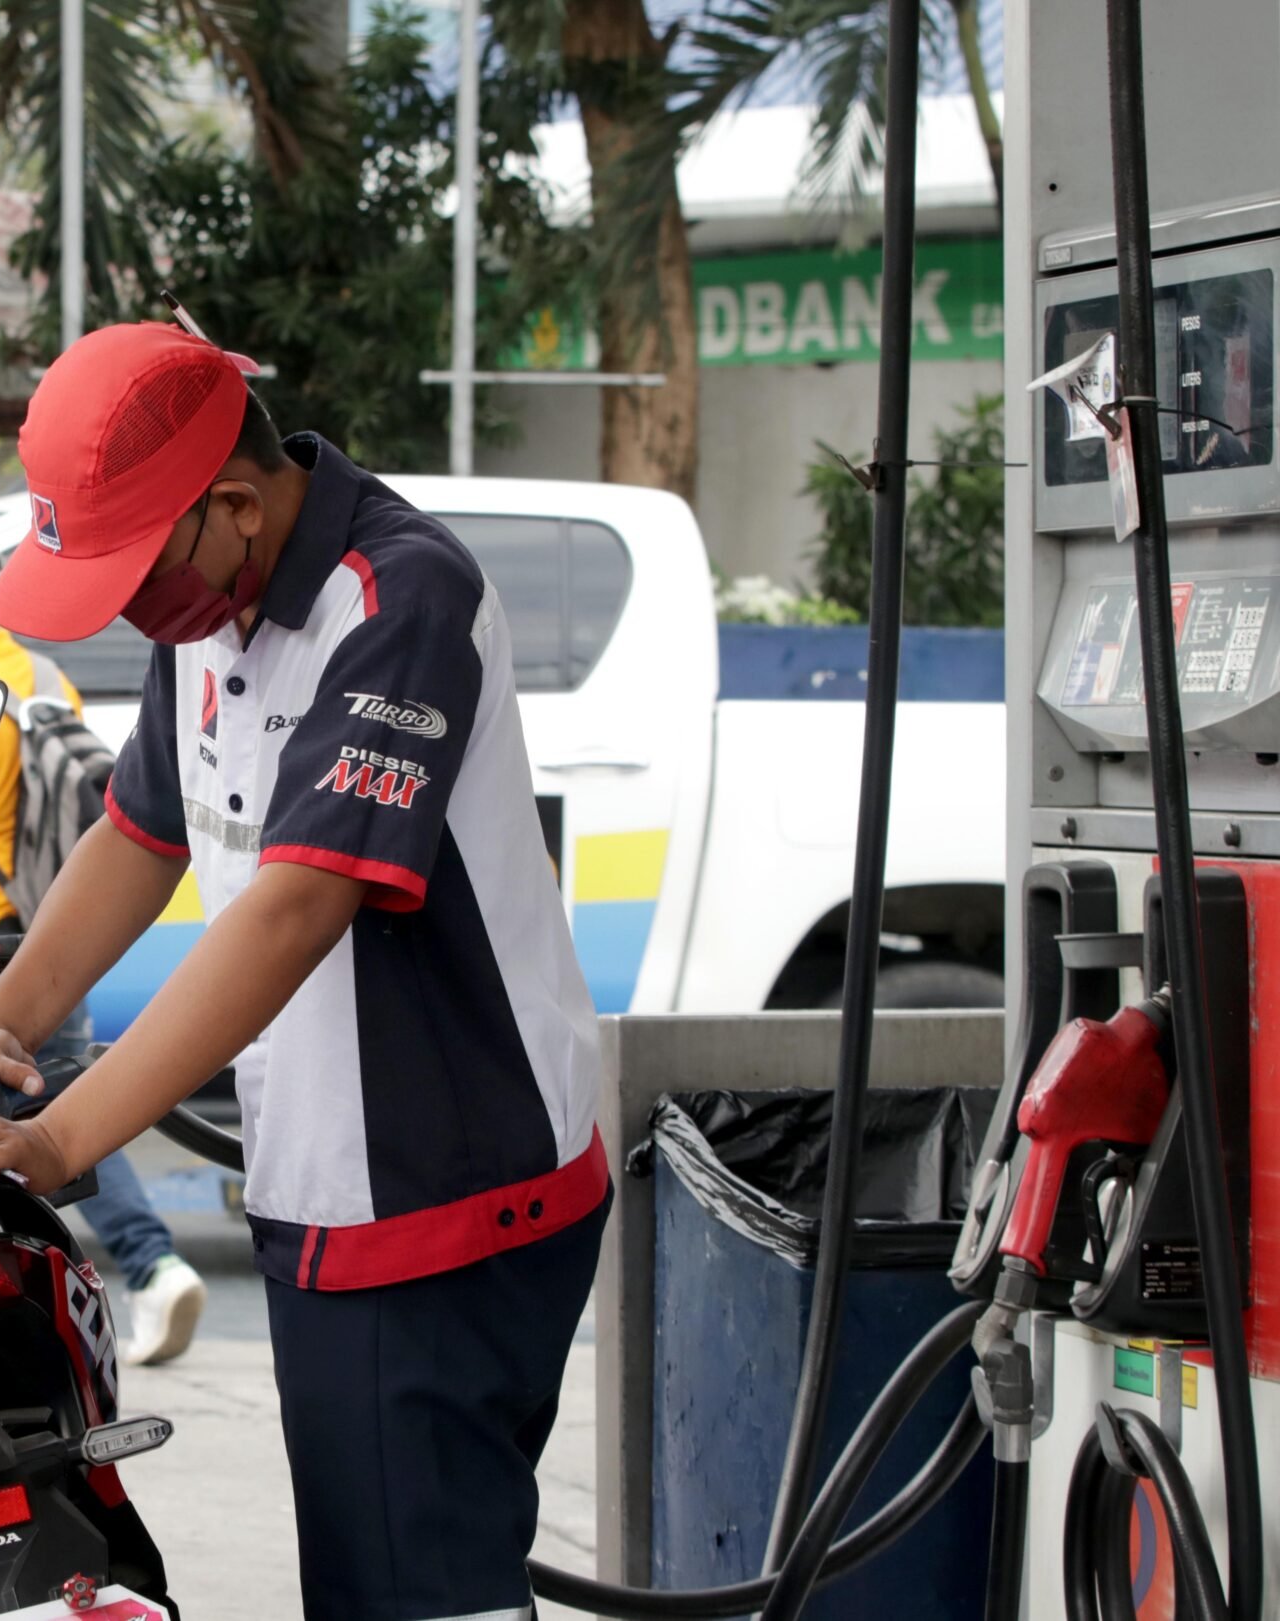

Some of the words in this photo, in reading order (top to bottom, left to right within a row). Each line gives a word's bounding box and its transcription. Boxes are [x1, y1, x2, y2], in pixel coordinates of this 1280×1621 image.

[343, 692, 432, 727] TURBO
[360, 711, 400, 728] DIESEL
[339, 745, 432, 781] DIESEL
[314, 758, 428, 809] MAX
